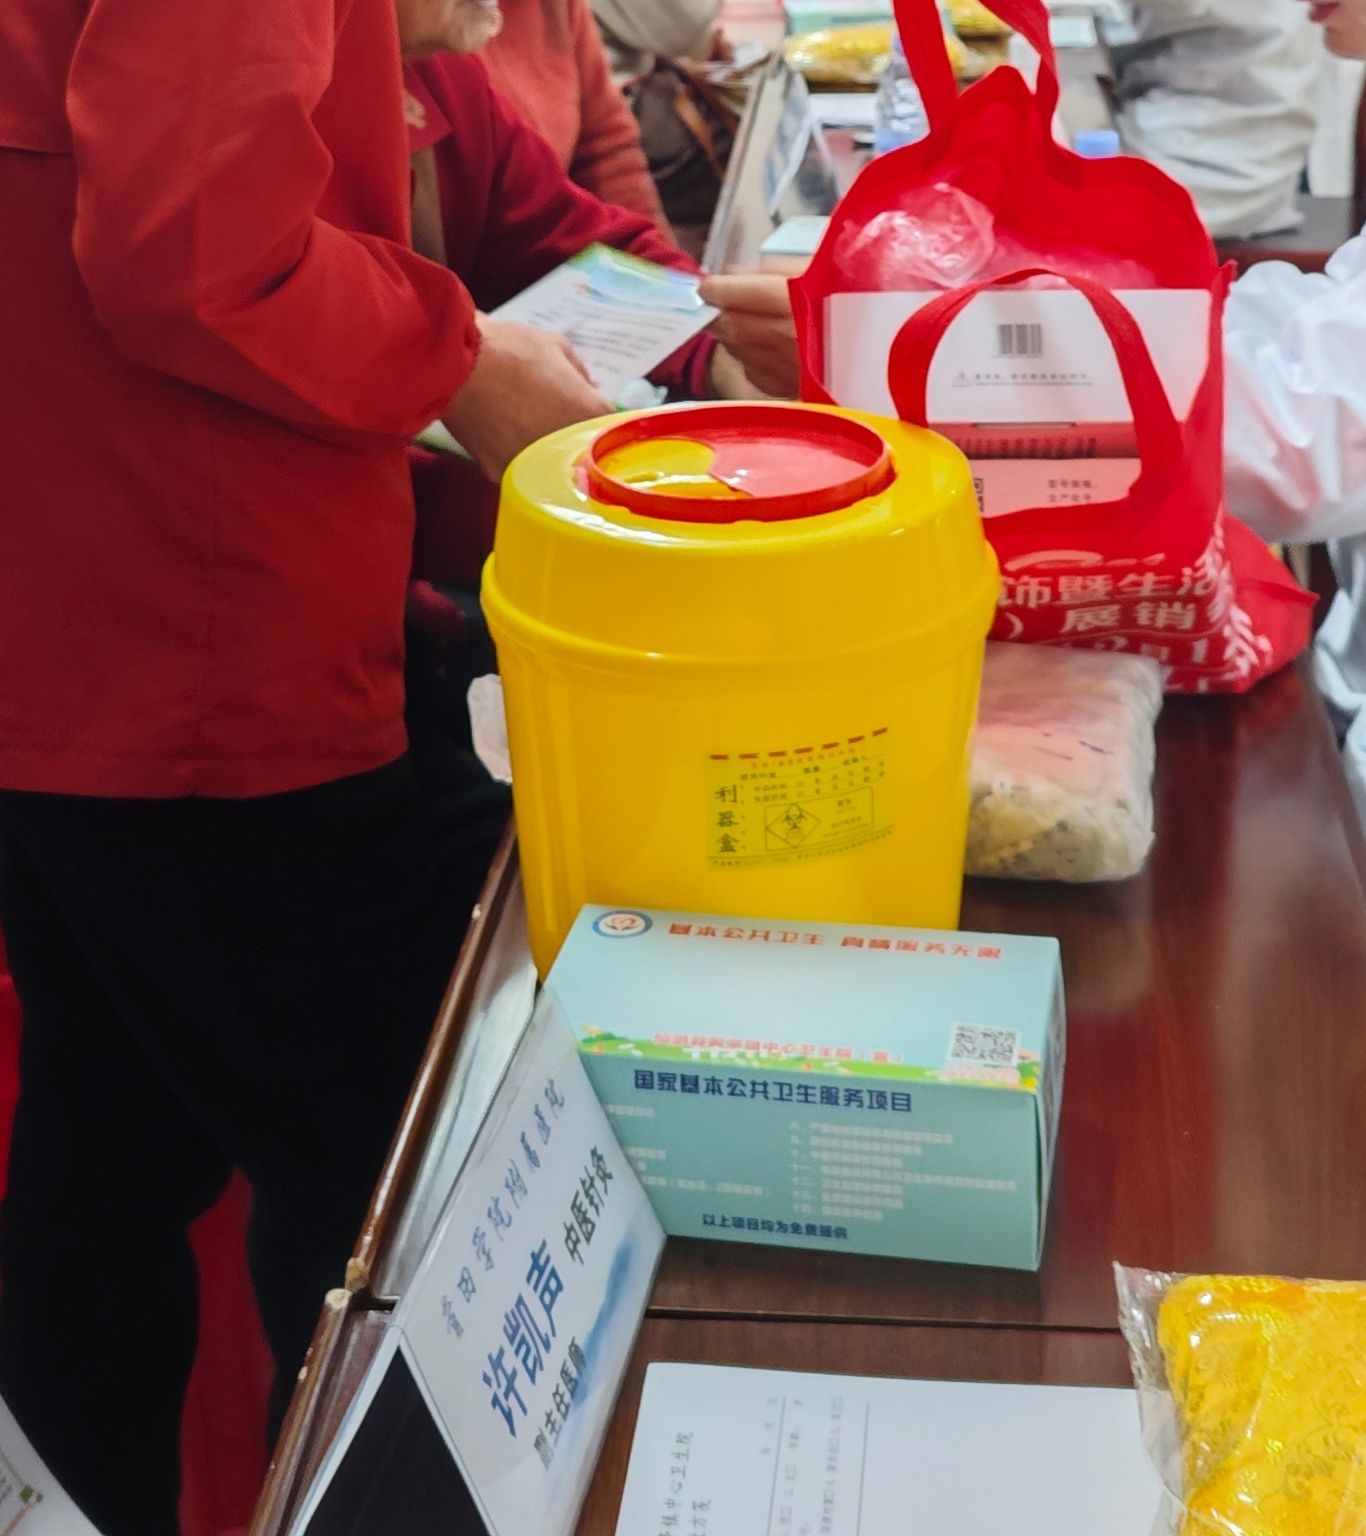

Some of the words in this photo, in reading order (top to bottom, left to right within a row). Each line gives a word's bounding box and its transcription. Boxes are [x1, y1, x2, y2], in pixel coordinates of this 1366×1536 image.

[714, 783, 740, 853] 利器盒
[668, 922, 826, 946] 基本公共卫生
[634, 1069, 913, 1113] 国家基本公共卫生服务项目
[702, 1213, 848, 1240] 以上项目均为免费提供
[482, 1238, 564, 1438] 许凯声
[562, 1145, 614, 1267] 中医针灸
[533, 1335, 589, 1471] 副主任医师
